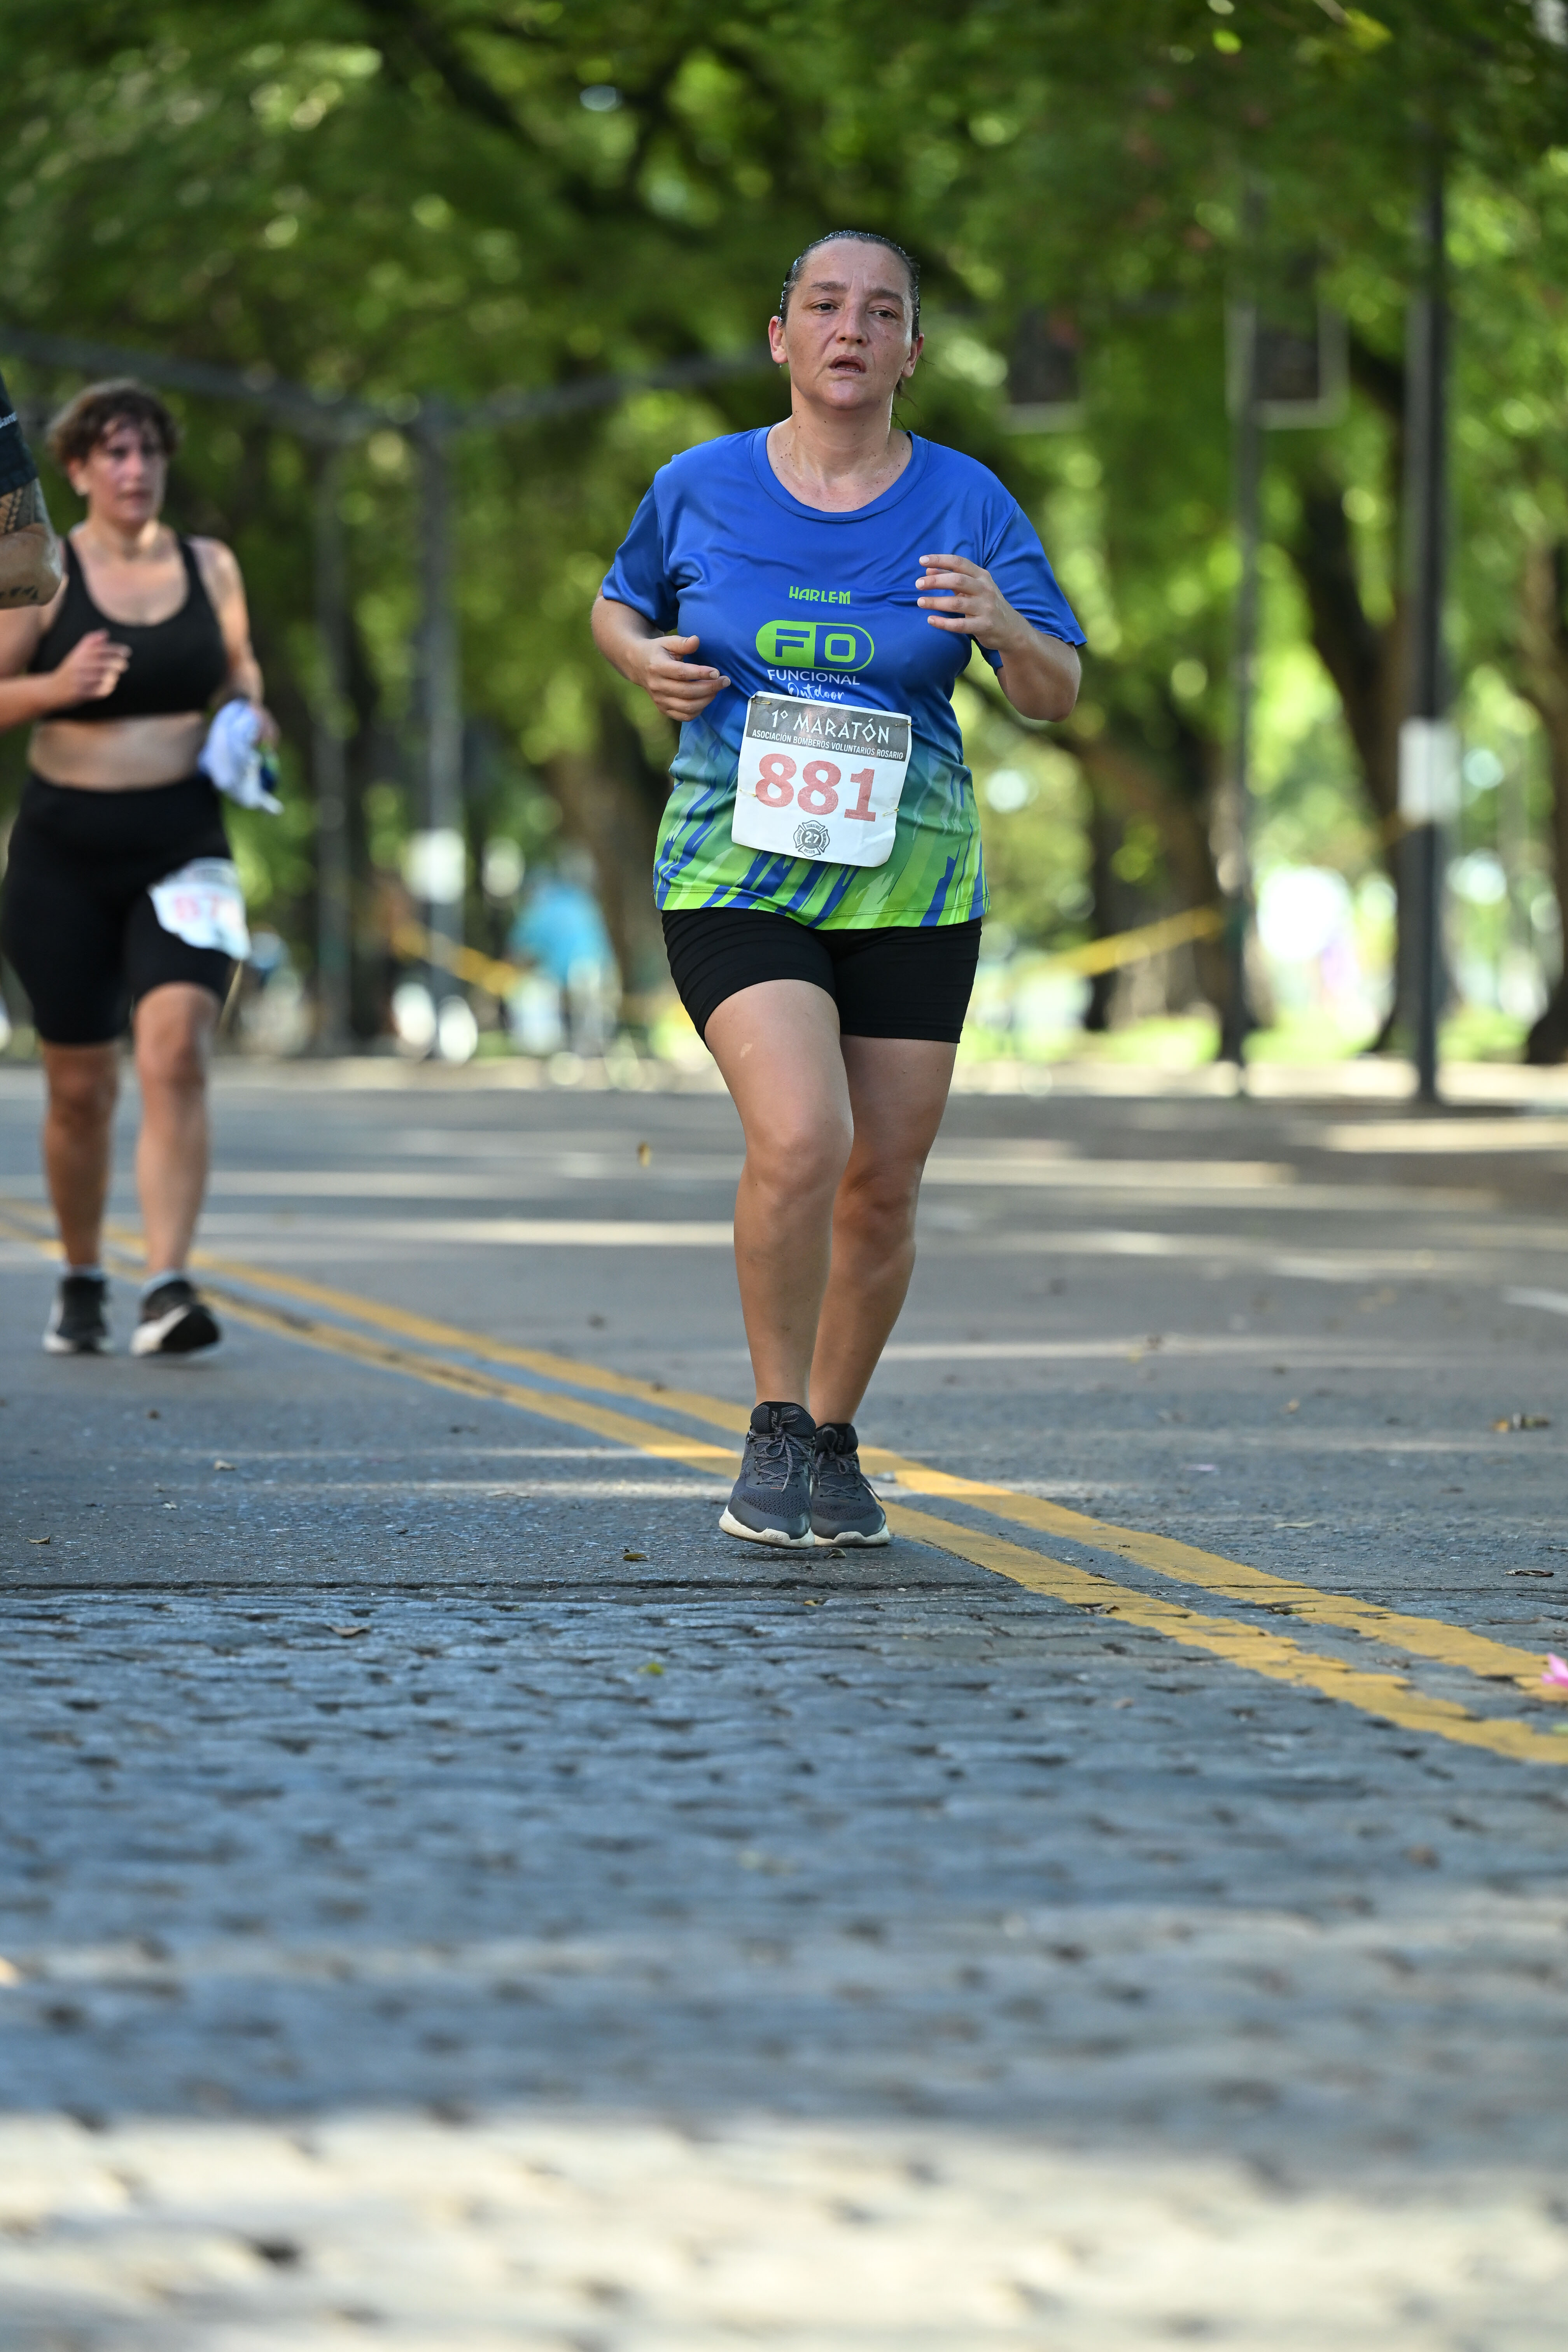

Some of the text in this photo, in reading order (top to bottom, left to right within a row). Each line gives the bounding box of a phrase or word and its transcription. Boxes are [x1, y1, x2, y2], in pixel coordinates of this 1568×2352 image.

[789, 586, 850, 604] HARLEM
[767, 669, 860, 685] FUNCIONAL
[788, 682, 844, 700] Outdoor
[793, 712, 889, 744] MARATÓN
[752, 729, 903, 760] ASOCIACIÓN BOMBEROS VOLUNTARIOS ROSARIO
[755, 753, 876, 822] 881
[805, 831, 819, 844] 27
